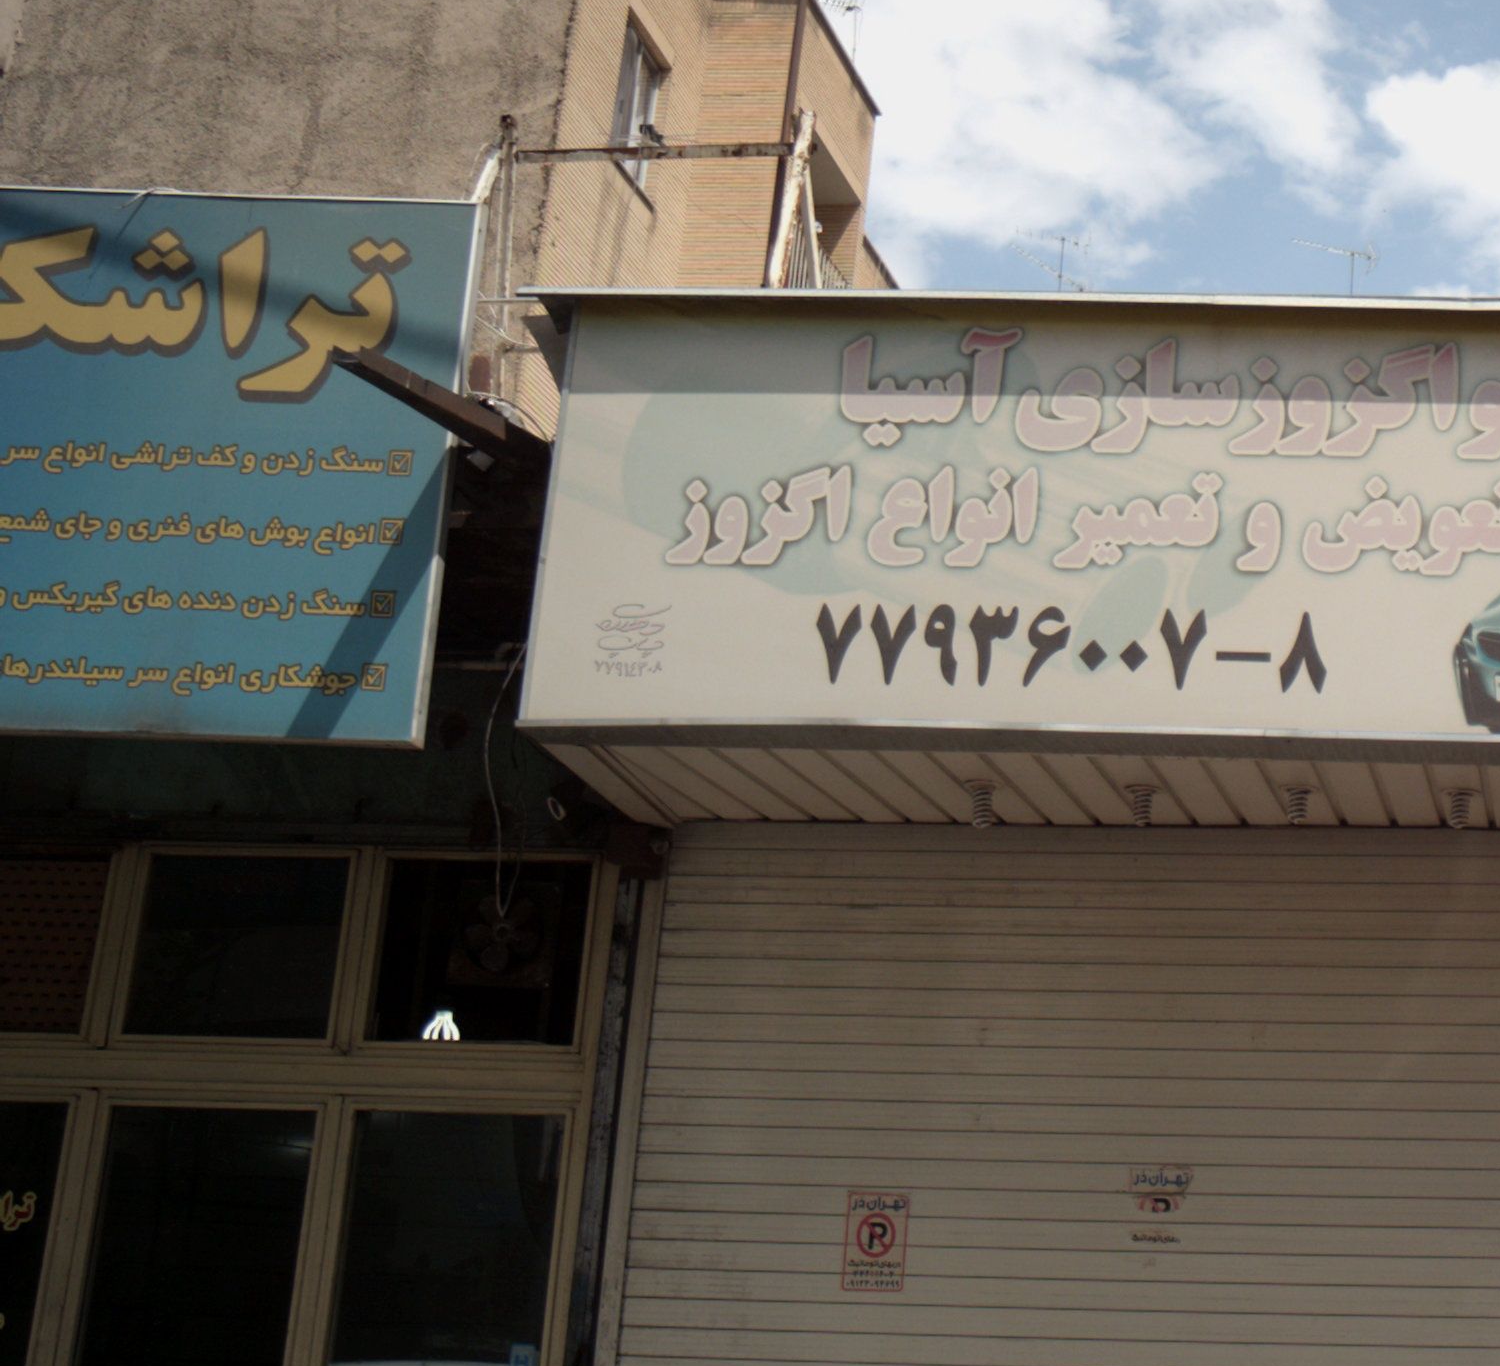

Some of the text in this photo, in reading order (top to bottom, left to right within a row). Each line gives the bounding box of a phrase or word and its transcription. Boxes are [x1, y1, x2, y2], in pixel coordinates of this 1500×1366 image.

[839, 327, 1024, 447] آسیا
[1015, 338, 1241, 455] سازی
[1228, 342, 1461, 458] اگزوز
[42, 440, 107, 475] انواع
[110, 440, 193, 472] تراشی
[195, 443, 239, 469] کف
[239, 452, 257, 474] و
[261, 447, 315, 476] زدن
[319, 445, 385, 474] سنگ
[55, 511, 102, 540] جای
[105, 519, 122, 541] و
[127, 512, 192, 543] فنری
[664, 464, 853, 566] اگزوز
[867, 464, 1040, 567] انواع
[1052, 472, 1224, 569] تعمیر
[195, 516, 246, 549] های
[249, 516, 310, 548] بوش
[313, 522, 377, 554] انواع
[1235, 501, 1282, 573] و
[12, 580, 121, 613] گیربکس
[123, 585, 173, 615] های
[178, 590, 237, 612] دنده
[241, 591, 297, 621] زدن
[301, 588, 367, 617] سنگ
[0, 652, 358, 696] جوشکاری انواع سر سیلندرها
[0, 1190, 38, 1231] ترا
[867, 1196, 906, 1211] تهران
